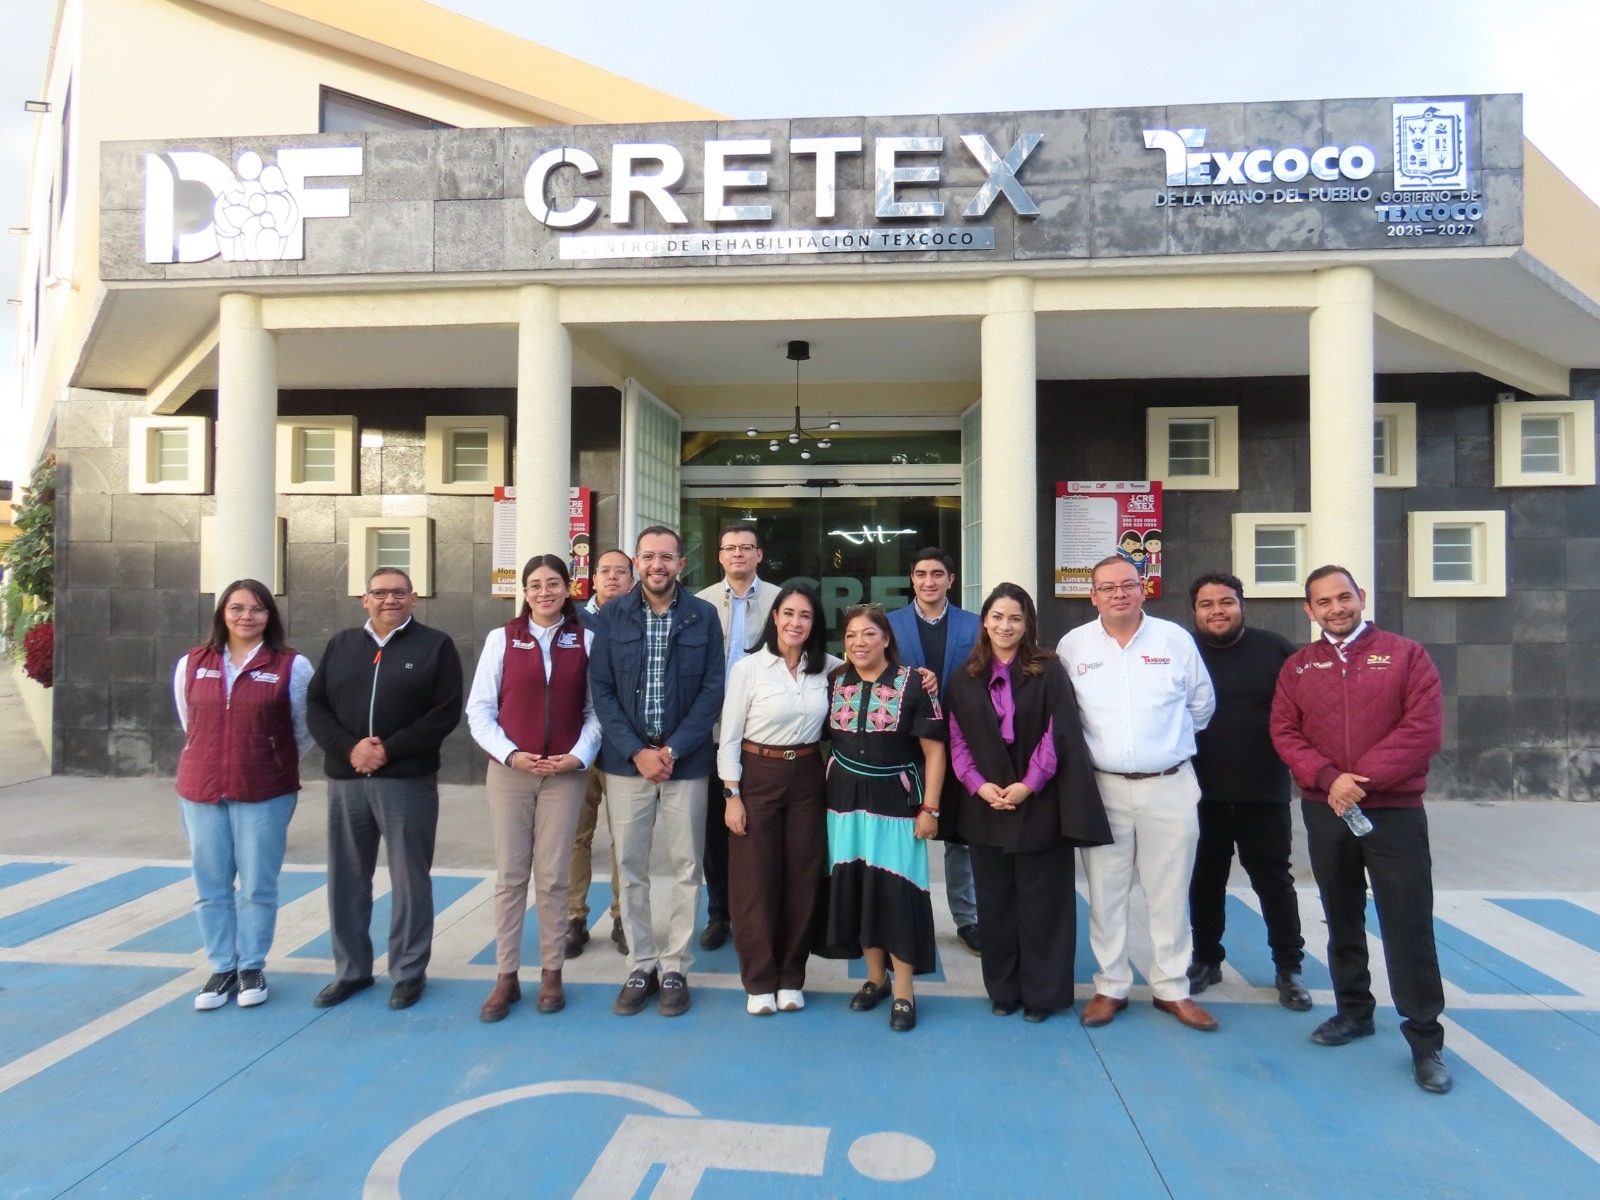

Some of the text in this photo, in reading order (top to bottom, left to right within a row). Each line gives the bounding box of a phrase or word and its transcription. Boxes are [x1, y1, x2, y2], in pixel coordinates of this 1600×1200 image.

[523, 134, 1045, 228] CRETEX
[1154, 187, 1373, 207] DE LA MANO DEL PUEBLO
[1380, 190, 1479, 203] GOBIERNO DE
[1374, 202, 1483, 223] TEXCOCO
[666, 239, 690, 252] DE
[702, 233, 871, 251] REHABILITACIÓN
[880, 231, 974, 247] TEXCOCO
